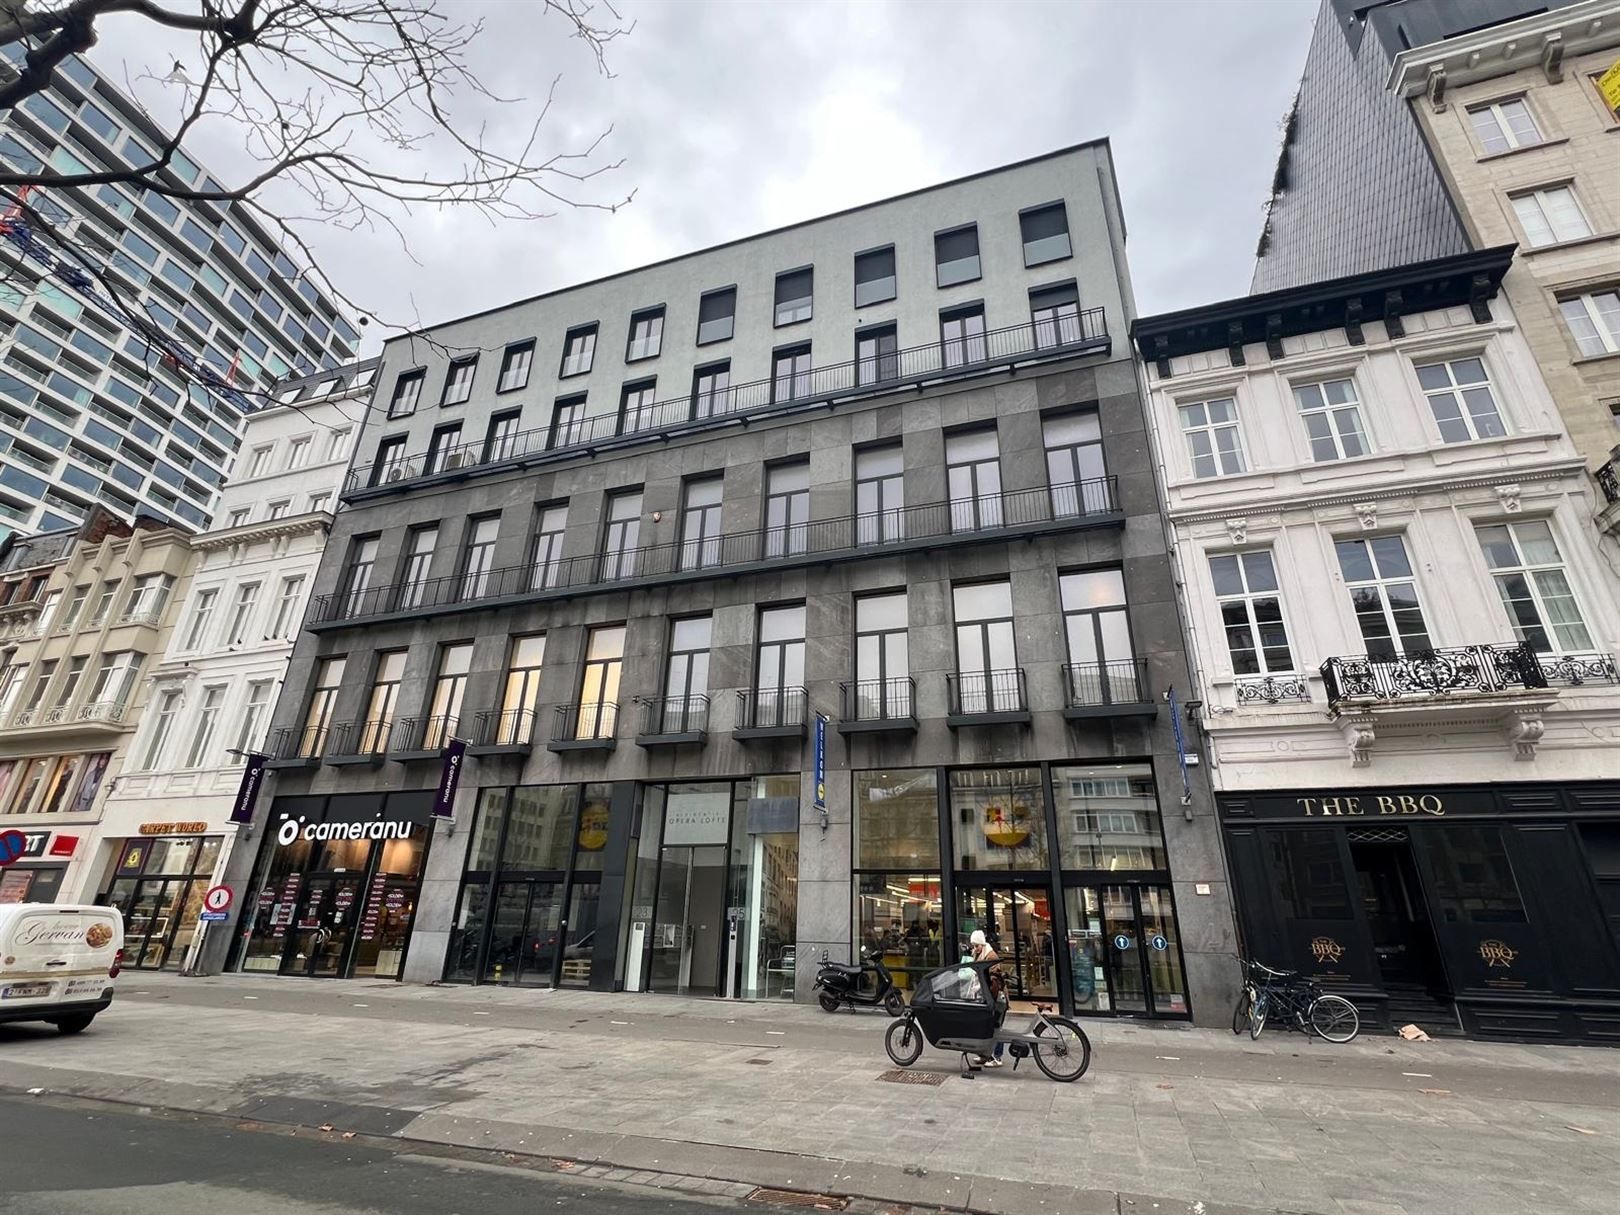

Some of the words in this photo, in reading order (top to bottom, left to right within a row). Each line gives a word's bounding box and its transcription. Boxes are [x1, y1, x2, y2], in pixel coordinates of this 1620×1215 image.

[241, 776, 256, 812] cameranu
[443, 766, 457, 803] cameranu
[1297, 797, 1365, 816] THE
[1376, 794, 1446, 816] BBQ
[303, 820, 412, 841] cameranu
[1311, 942, 1342, 956] BBQ
[1479, 946, 1514, 960] BBQ
